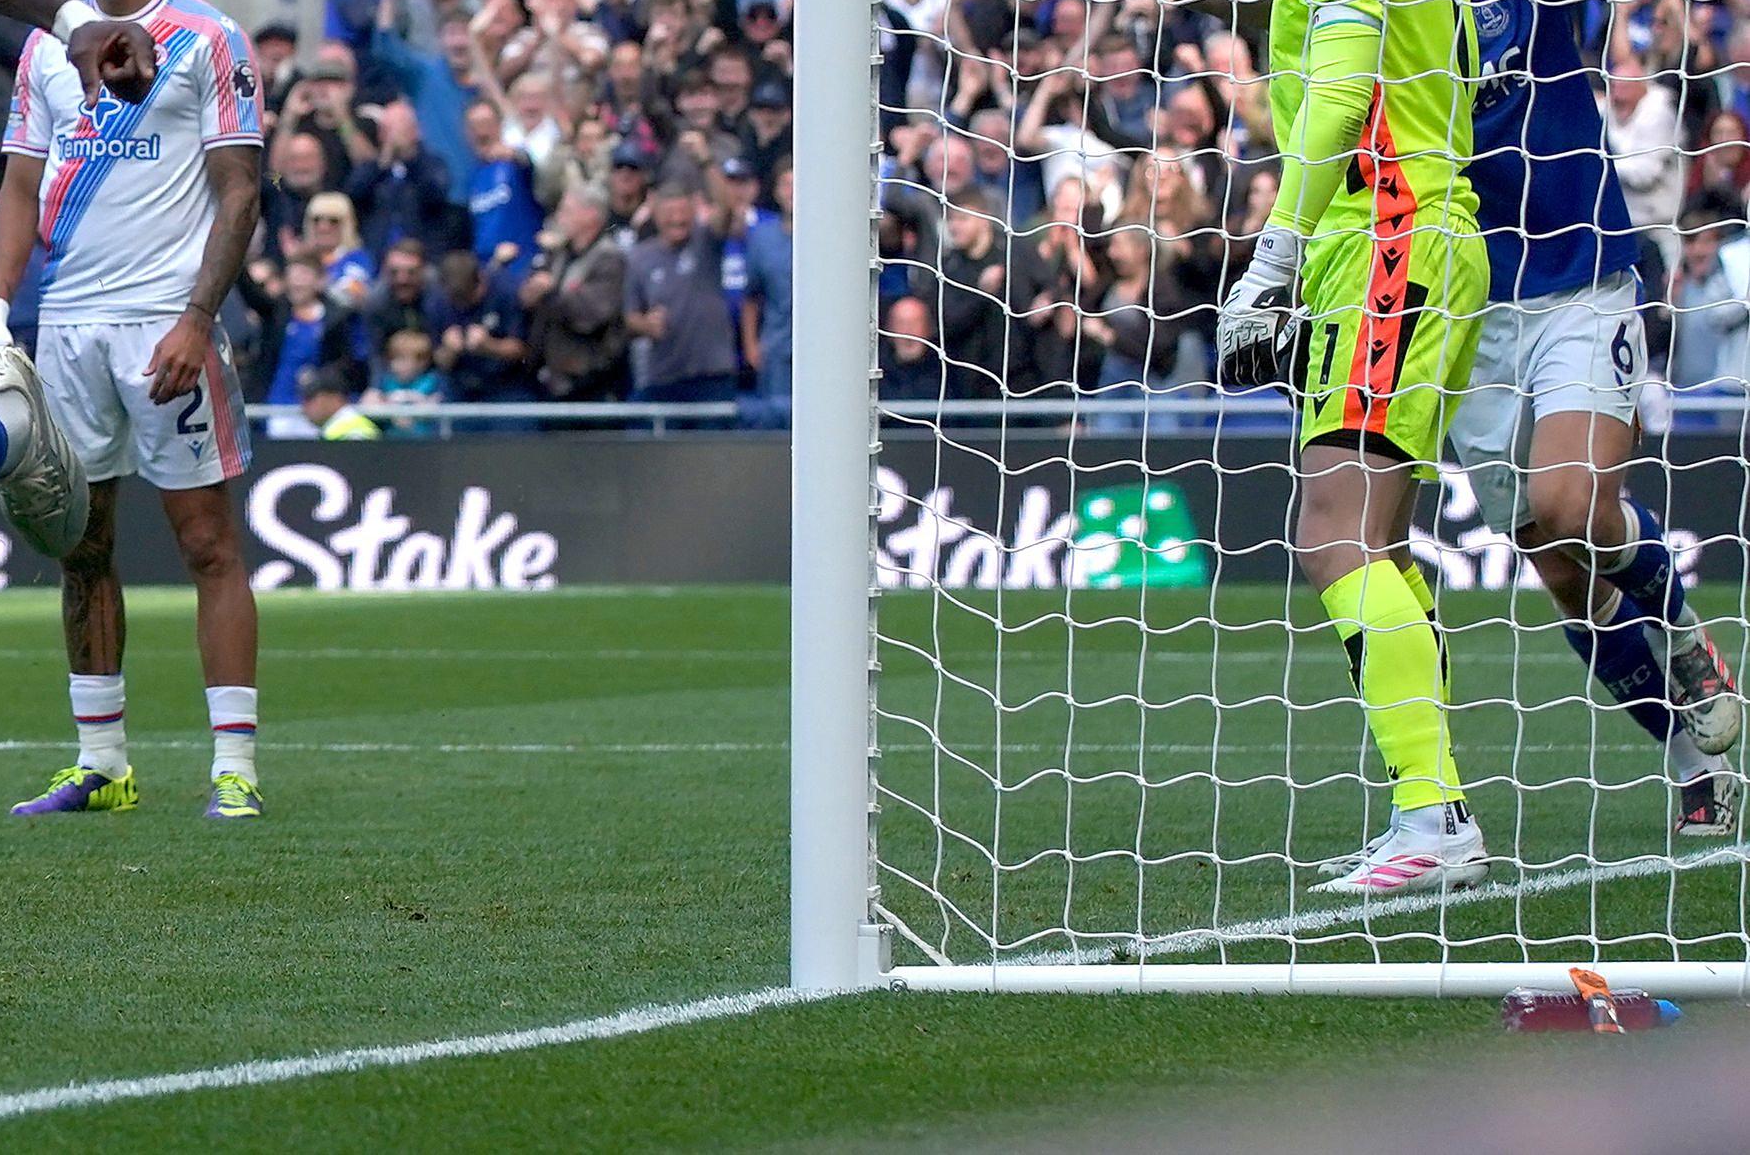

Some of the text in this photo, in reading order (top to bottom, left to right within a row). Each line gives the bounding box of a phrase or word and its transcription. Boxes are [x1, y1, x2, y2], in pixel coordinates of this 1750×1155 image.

[57, 132, 162, 161] Temporal
[1318, 323, 1340, 385] 1
[1610, 321, 1634, 375] 6
[176, 384, 208, 434] 2
[247, 462, 561, 592] Stake
